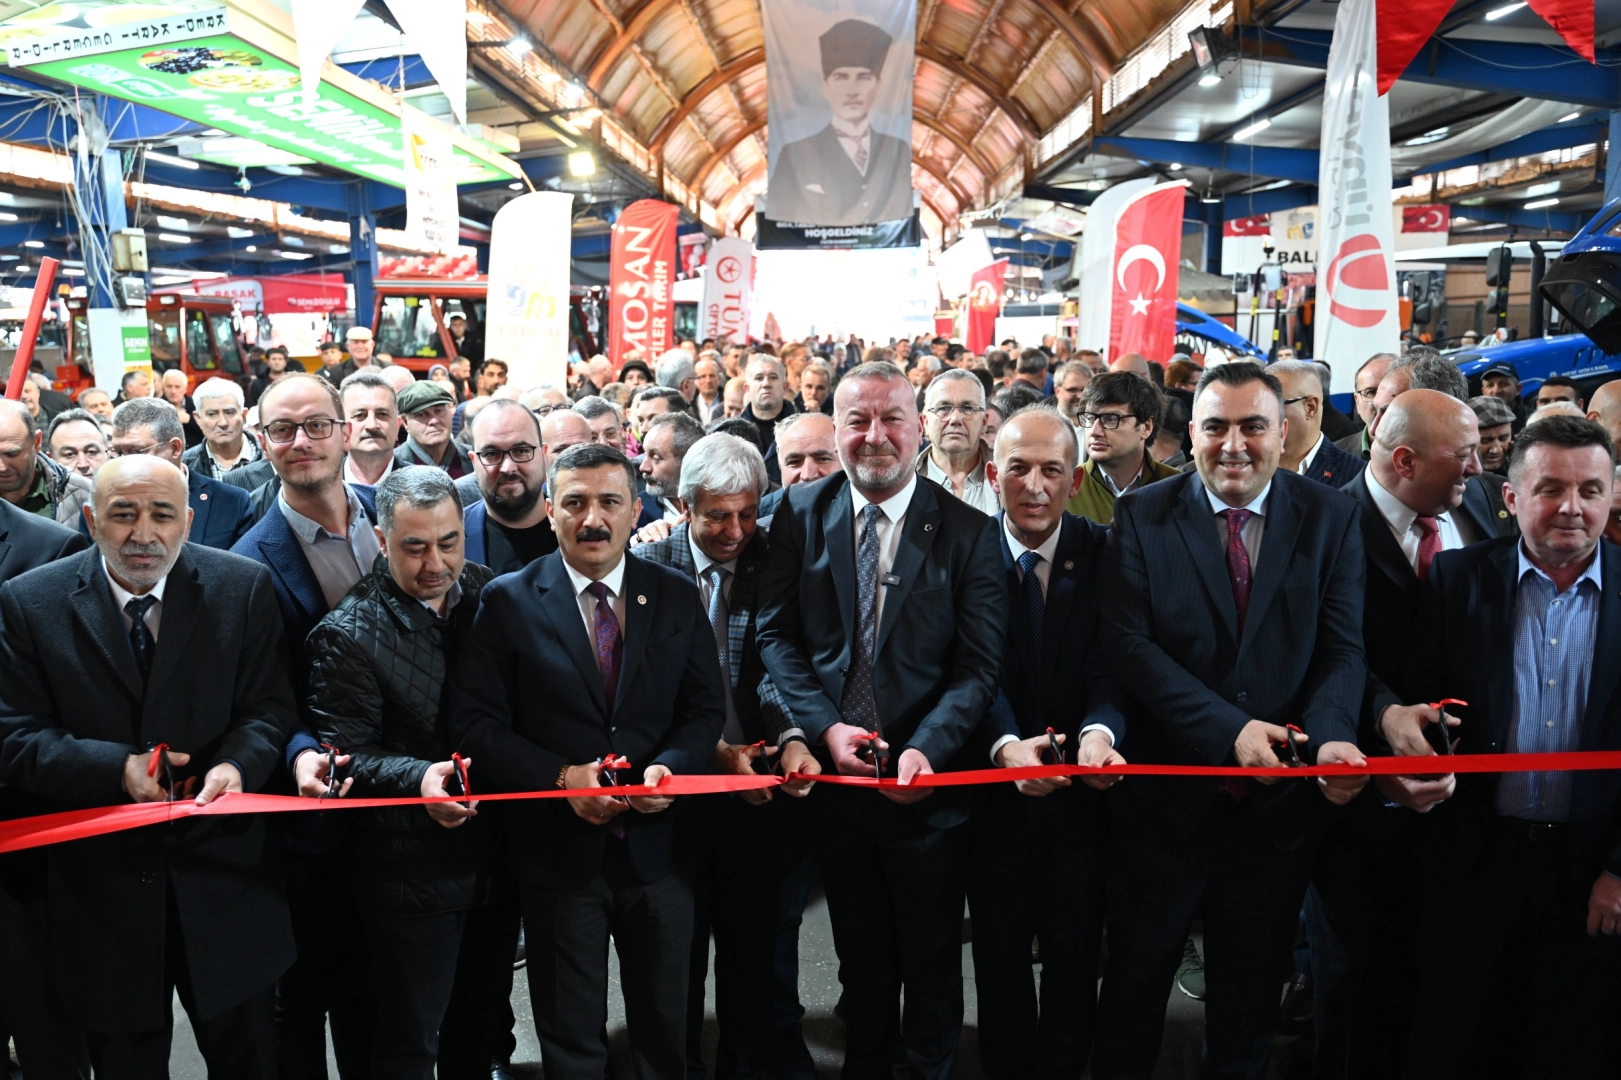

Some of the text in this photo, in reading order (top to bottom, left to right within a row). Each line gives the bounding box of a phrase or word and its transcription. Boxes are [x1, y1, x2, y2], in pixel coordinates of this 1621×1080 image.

[121, 23, 170, 40] KARTI
[177, 14, 226, 32] KREDİ
[804, 226, 874, 240] HOŞGELDİNİZ
[652, 260, 668, 312] TARIM
